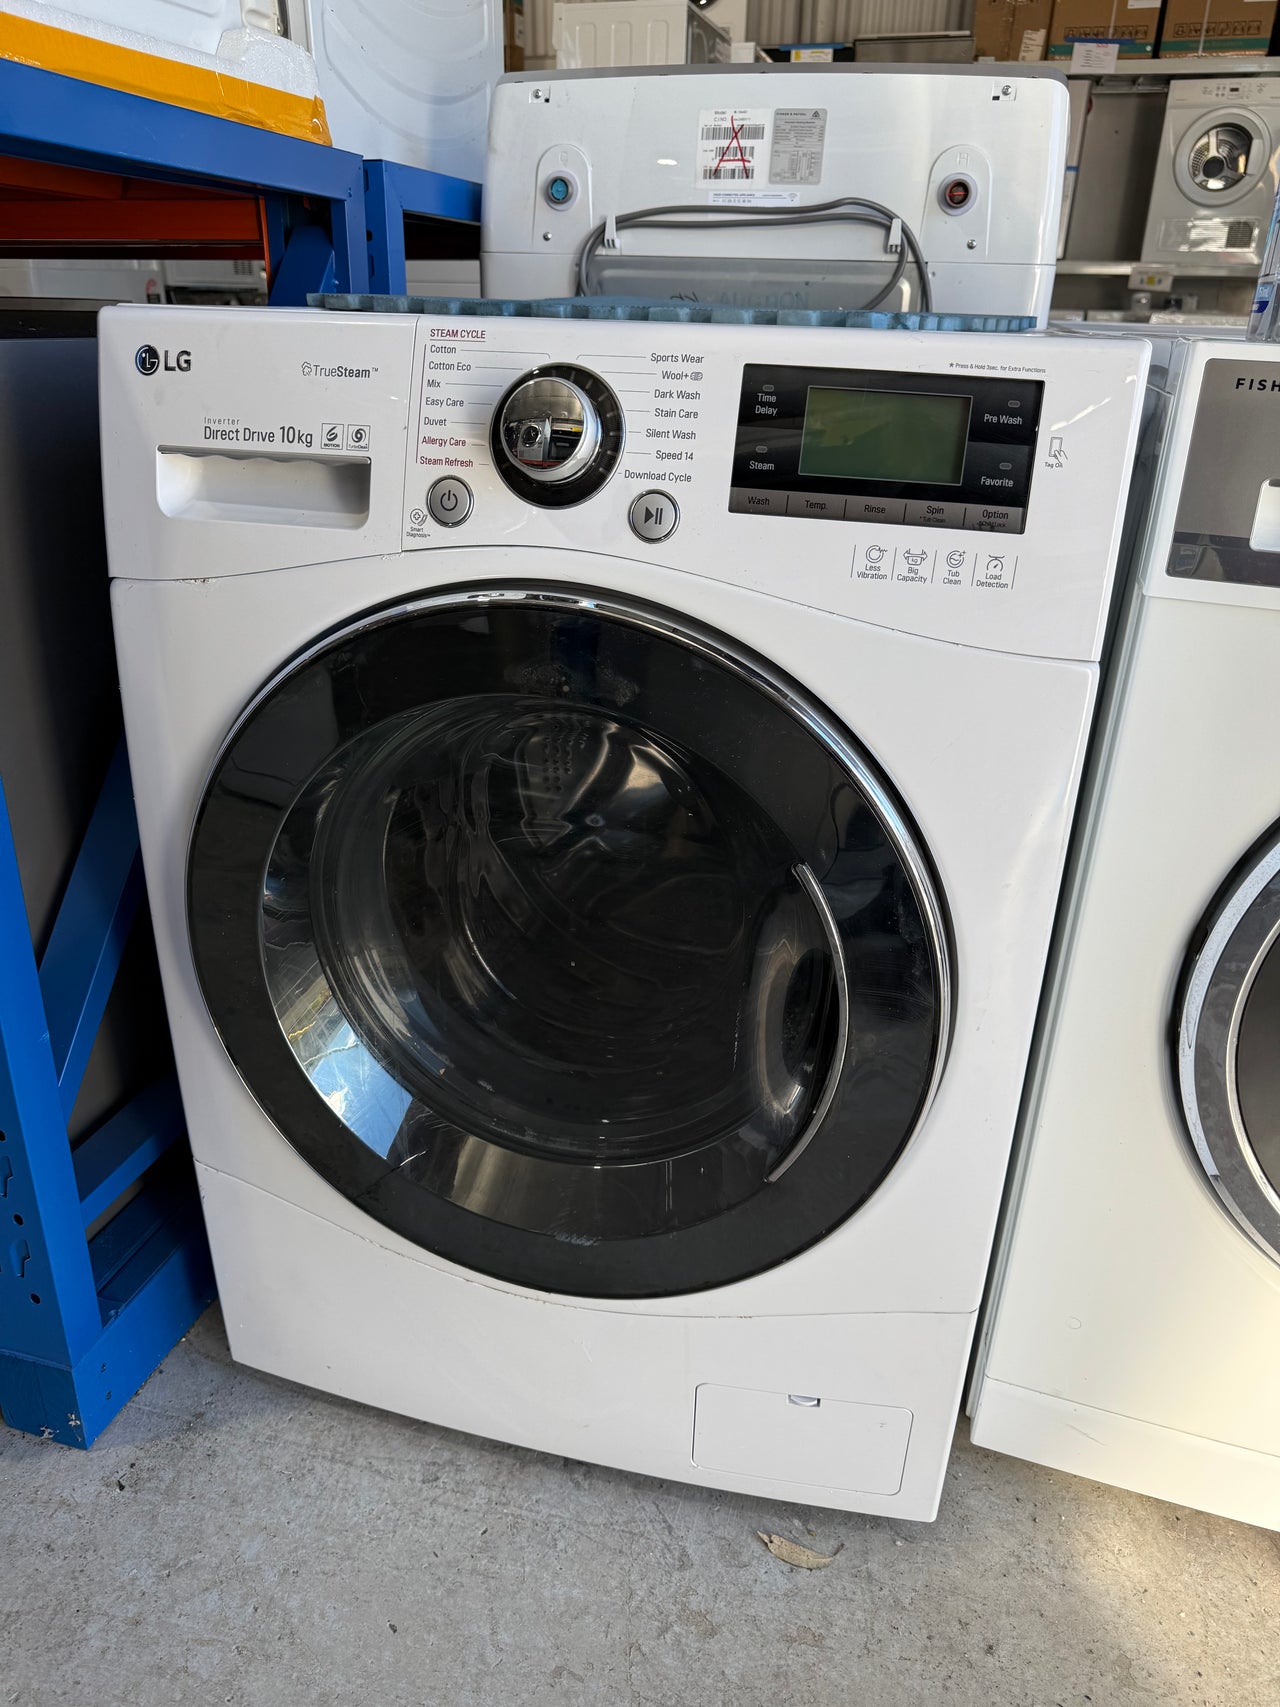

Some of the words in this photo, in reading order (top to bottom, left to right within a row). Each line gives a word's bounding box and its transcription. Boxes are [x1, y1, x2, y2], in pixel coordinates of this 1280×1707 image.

[430, 329, 458, 338] STEAM
[460, 330, 486, 339] CYCLE
[430, 345, 456, 354] Cotton
[164, 350, 192, 372] LG
[651, 353, 679, 363] Sports
[681, 354, 704, 363] Wear
[429, 361, 455, 370] Cotton
[457, 362, 471, 371] Eco
[662, 371, 689, 380] Wool+
[427, 379, 441, 388] Mix
[654, 389, 675, 399] Dark
[677, 390, 701, 400] Wash
[757, 393, 777, 403] Time
[426, 397, 444, 407] Easy
[446, 398, 464, 407] Care
[655, 408, 676, 417] Stain
[679, 409, 698, 418] Care
[755, 405, 778, 416] Delay
[204, 416, 240, 425] Inverter
[424, 417, 447, 426] Duvet
[984, 413, 998, 423] Pre
[999, 415, 1023, 425] Wash
[204, 426, 240, 441] Direct
[243, 428, 275, 443] Drive
[646, 428, 670, 439] Silent
[672, 430, 697, 440] Wash
[422, 436, 448, 447] Allergy
[449, 437, 466, 446] Care
[656, 450, 683, 461] Speed
[685, 452, 694, 460] 14
[420, 456, 443, 466] Steam
[445, 458, 473, 467] Refresh
[749, 461, 775, 470] Steam
[624, 470, 666, 481] Download
[668, 472, 692, 483] Cycle
[981, 476, 1014, 487] Favorite
[748, 496, 770, 506] Wash
[805, 500, 829, 511] Temp.
[864, 505, 886, 514] Rinse
[926, 505, 944, 515] Spin
[982, 509, 1009, 520] Option
[857, 571, 888, 580] Vibration
[907, 567, 919, 575] Big
[897, 574, 928, 584] Capacity
[943, 577, 961, 585] Clean
[976, 579, 1009, 589] Detection
